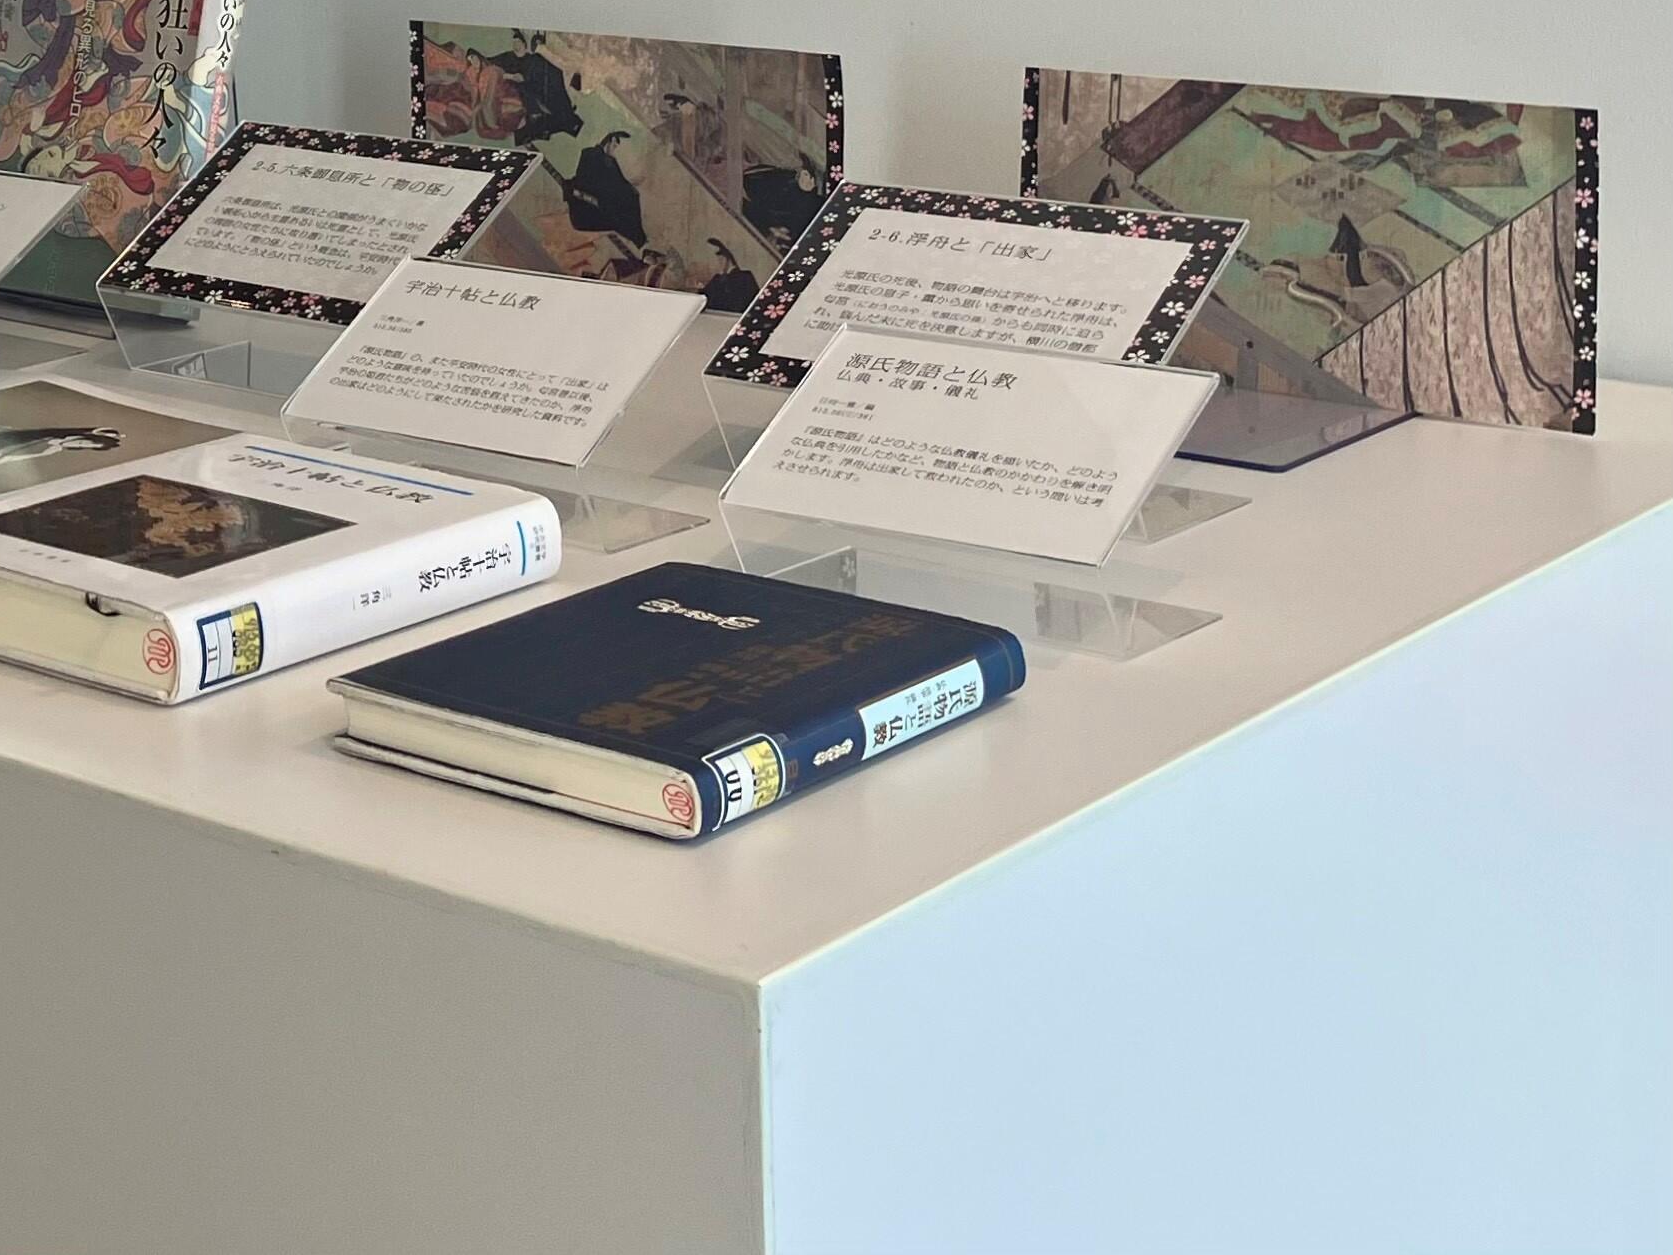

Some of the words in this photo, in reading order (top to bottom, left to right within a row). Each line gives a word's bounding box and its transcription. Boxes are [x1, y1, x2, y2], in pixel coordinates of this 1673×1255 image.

[867, 230, 1052, 259] 2-6.浮舟と「出家」
[402, 280, 542, 309] 宇治十帖と仏教
[835, 370, 982, 399] 仏典・故事・儀礼
[844, 353, 1019, 389] 源氏物語と仏教
[419, 543, 513, 593] 宇治十帖と仏教
[873, 681, 978, 748] 源氏物語と仏教
